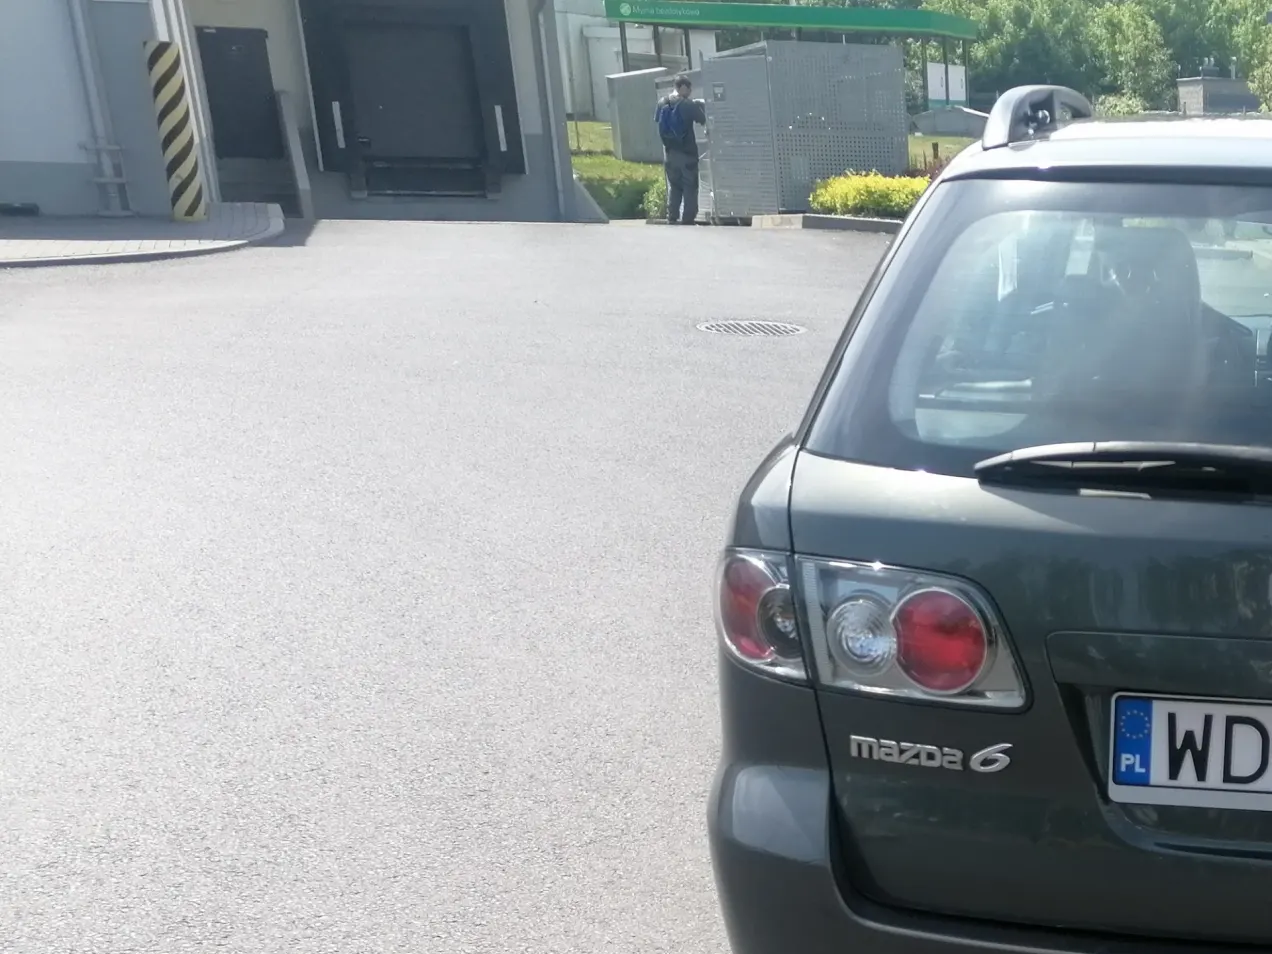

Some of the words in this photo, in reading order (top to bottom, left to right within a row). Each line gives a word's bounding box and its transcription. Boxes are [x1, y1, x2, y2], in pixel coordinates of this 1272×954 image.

[969, 743, 1013, 773] 6
[1167, 711, 1271, 785] WD
[1120, 753, 1146, 774] PL
